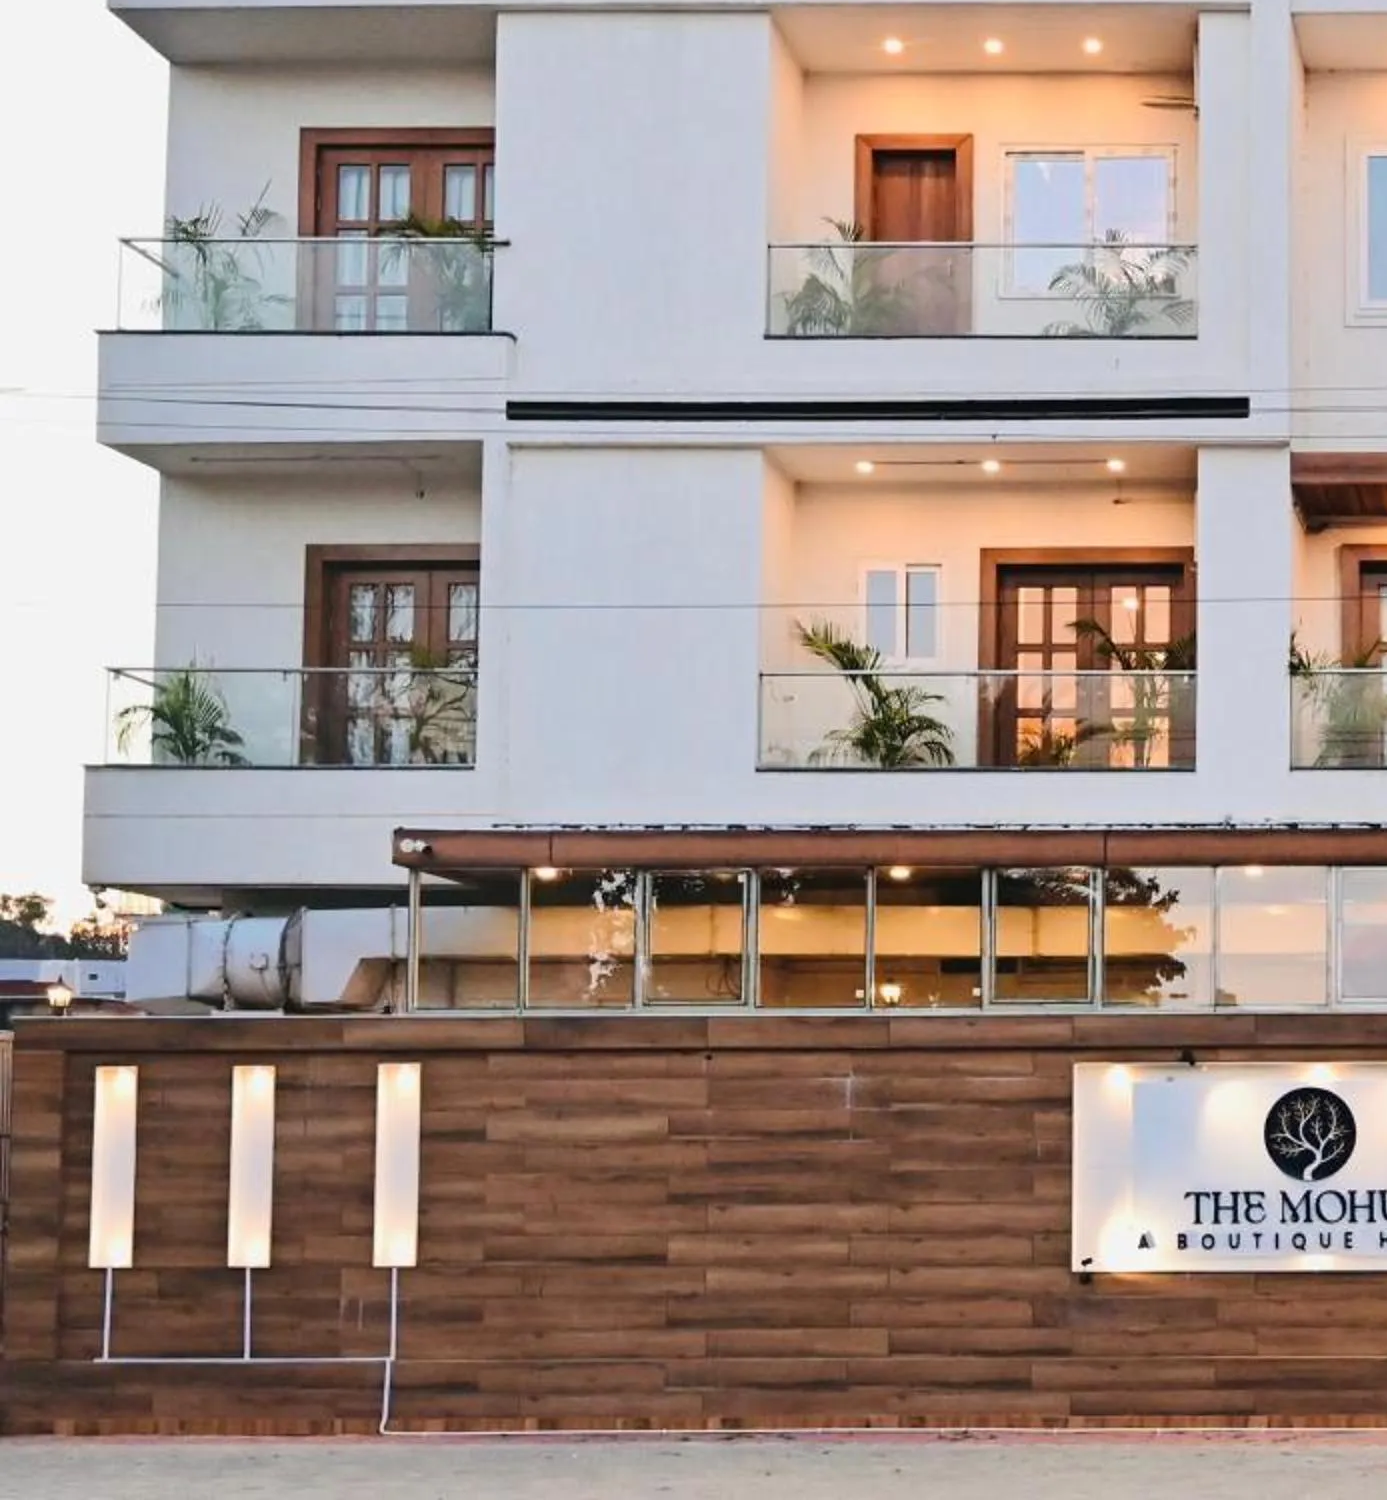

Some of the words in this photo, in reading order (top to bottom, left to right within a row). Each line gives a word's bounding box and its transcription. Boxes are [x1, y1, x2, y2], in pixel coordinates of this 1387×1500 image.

[1184, 1190, 1266, 1224] THE
[1138, 1231, 1152, 1250] A
[1177, 1231, 1355, 1251] BOUTIQUE
